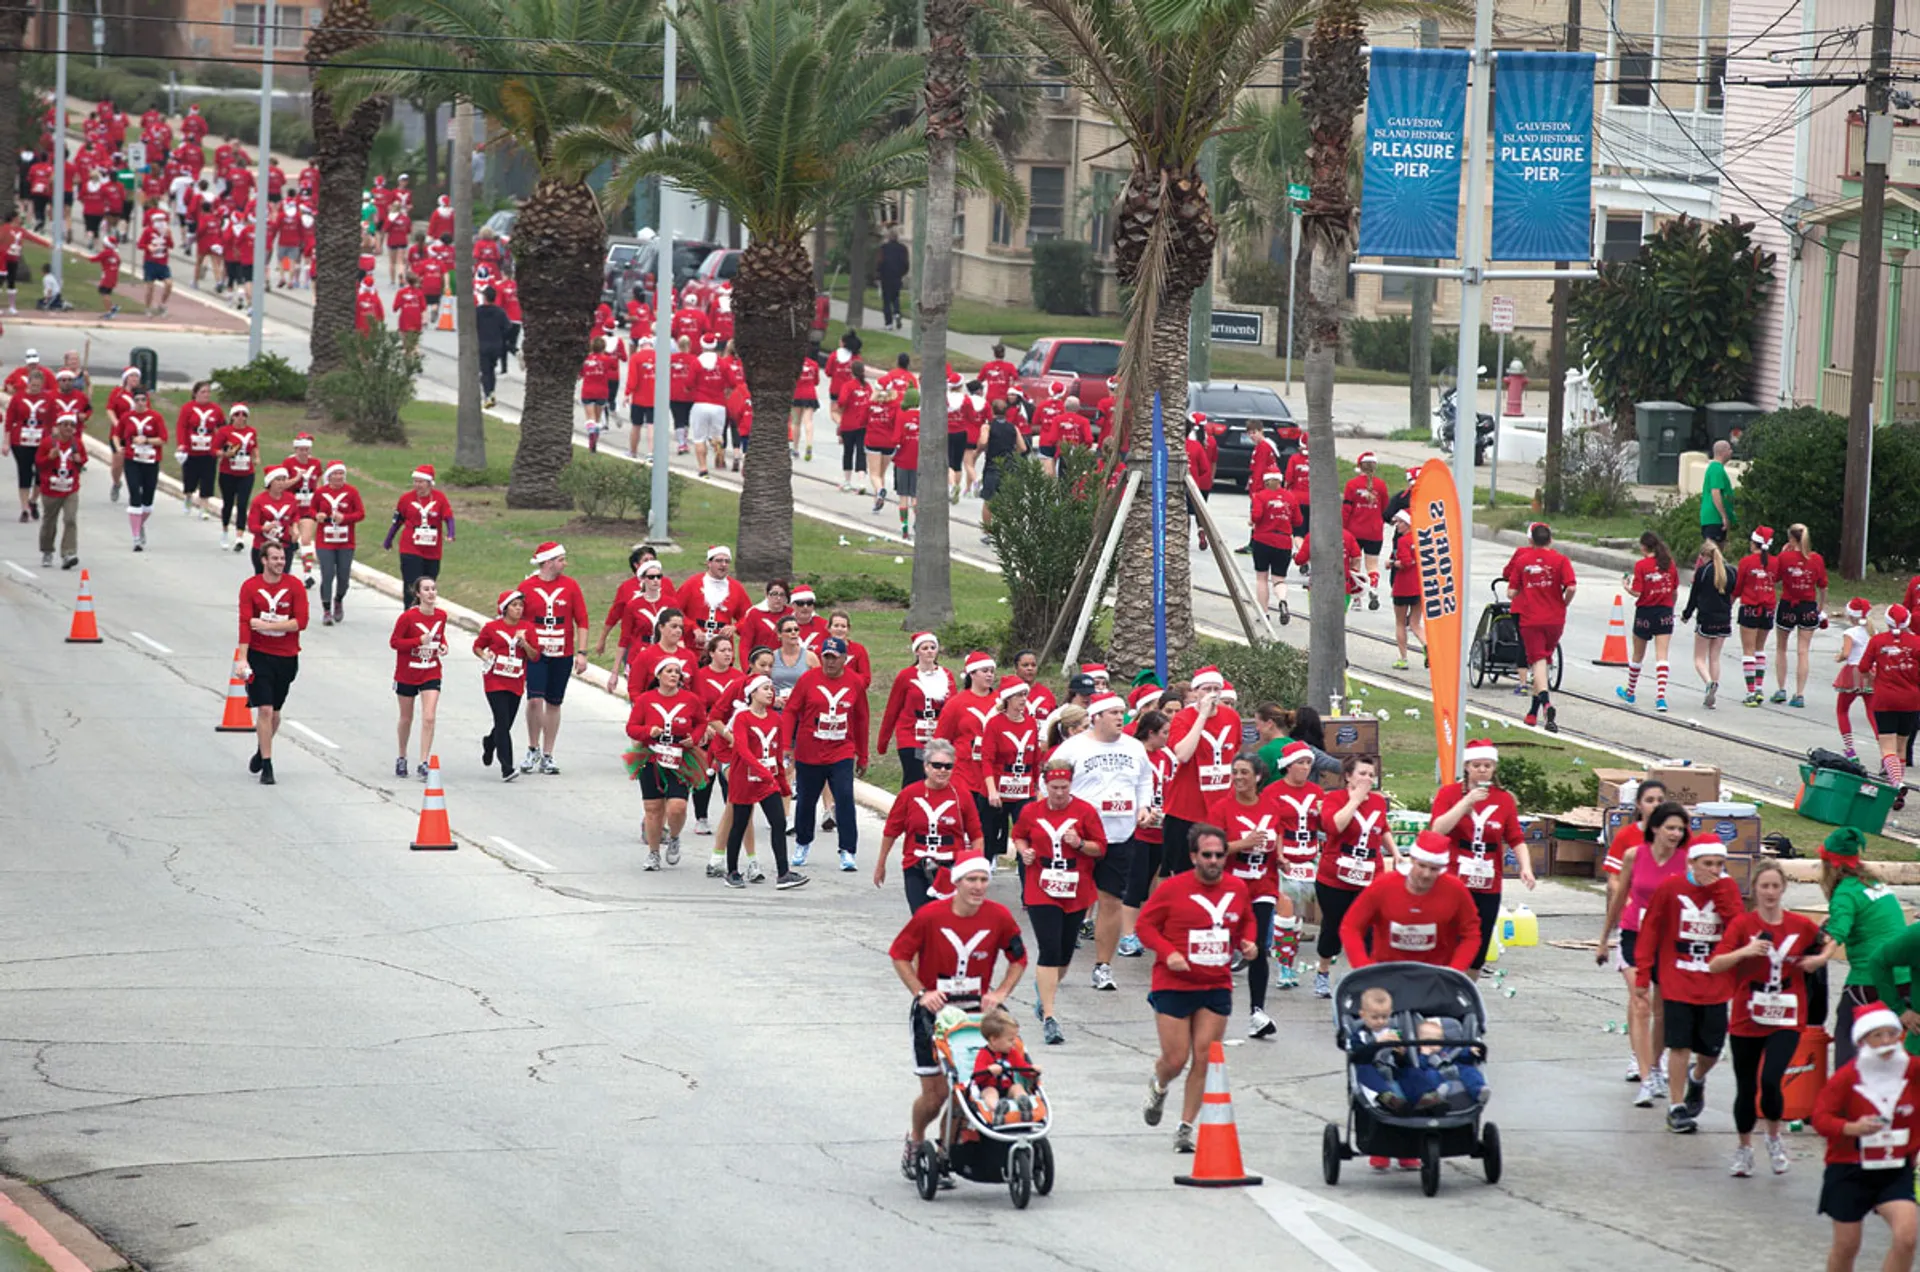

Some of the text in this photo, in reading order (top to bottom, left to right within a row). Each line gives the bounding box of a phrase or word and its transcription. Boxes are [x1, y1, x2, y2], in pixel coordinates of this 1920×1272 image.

[1387, 117, 1443, 128] GALVESTON
[1515, 121, 1572, 131] GALVESTON
[1374, 128, 1456, 140] ISLAND HISTORIC
[1502, 133, 1585, 143] ISLAND HISTORIC
[1372, 141, 1456, 160] PLEASURE
[1501, 147, 1585, 162] PLEASURE
[1394, 162, 1430, 178] PIER
[1524, 166, 1560, 181] PIER
